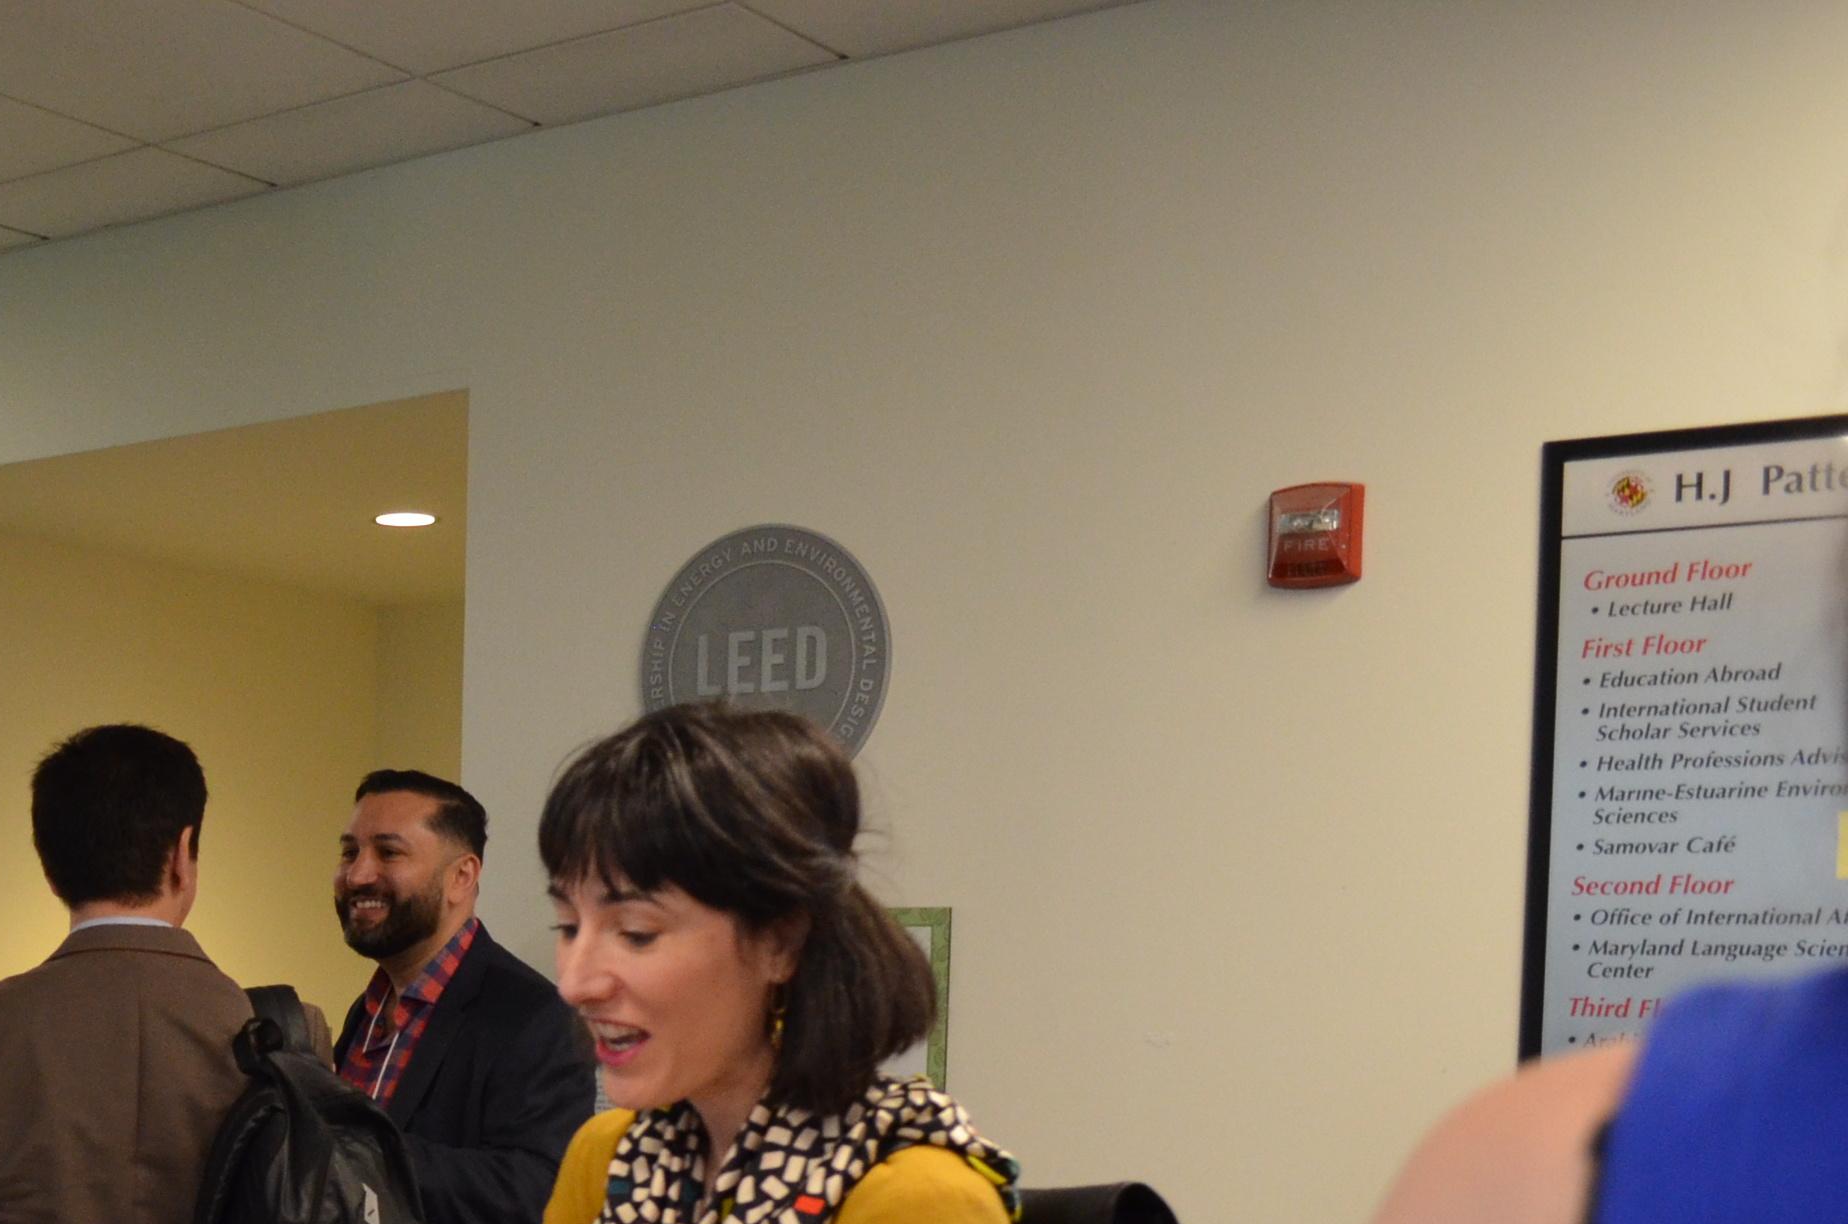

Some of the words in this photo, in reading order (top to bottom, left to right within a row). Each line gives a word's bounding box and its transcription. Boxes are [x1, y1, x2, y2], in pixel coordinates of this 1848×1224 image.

[1675, 470, 1731, 504] H.J
[1283, 537, 1329, 553] FIRE
[1583, 562, 1679, 592] Ground
[1686, 559, 1753, 583] Floor
[1608, 599, 1682, 618] Lecture
[1690, 592, 1733, 612] Hall
[672, 547, 734, 608] ENERGY
[740, 537, 778, 557] AND
[784, 539, 877, 670] ENVIRONMENTAL
[840, 679, 876, 740] DESIG
[1581, 638, 1634, 659] First
[1642, 634, 1707, 656] Floor
[696, 625, 829, 697] LEED
[1600, 667, 1699, 688] Education
[1704, 662, 1782, 682] Abroad
[1599, 696, 1729, 719] International
[1737, 693, 1816, 713] Student
[1596, 722, 1670, 742] Scholar
[1677, 719, 1761, 739] Services
[1596, 752, 1663, 771] Health
[1670, 748, 1784, 770] Professions
[1595, 781, 1768, 803] Marine-Estuarine
[1592, 808, 1678, 825] Sciences
[1592, 838, 1679, 856] Samovar
[1686, 835, 1736, 854] Café
[1571, 873, 1661, 897] Second
[1668, 873, 1735, 896] Floor
[1590, 907, 1652, 926] Office
[1659, 907, 1682, 926] of
[1686, 906, 1821, 926] International
[1588, 939, 1684, 963] Maryland
[1691, 939, 1788, 962] Language
[1586, 962, 1654, 979] Center
[1569, 996, 1631, 1018] Third
